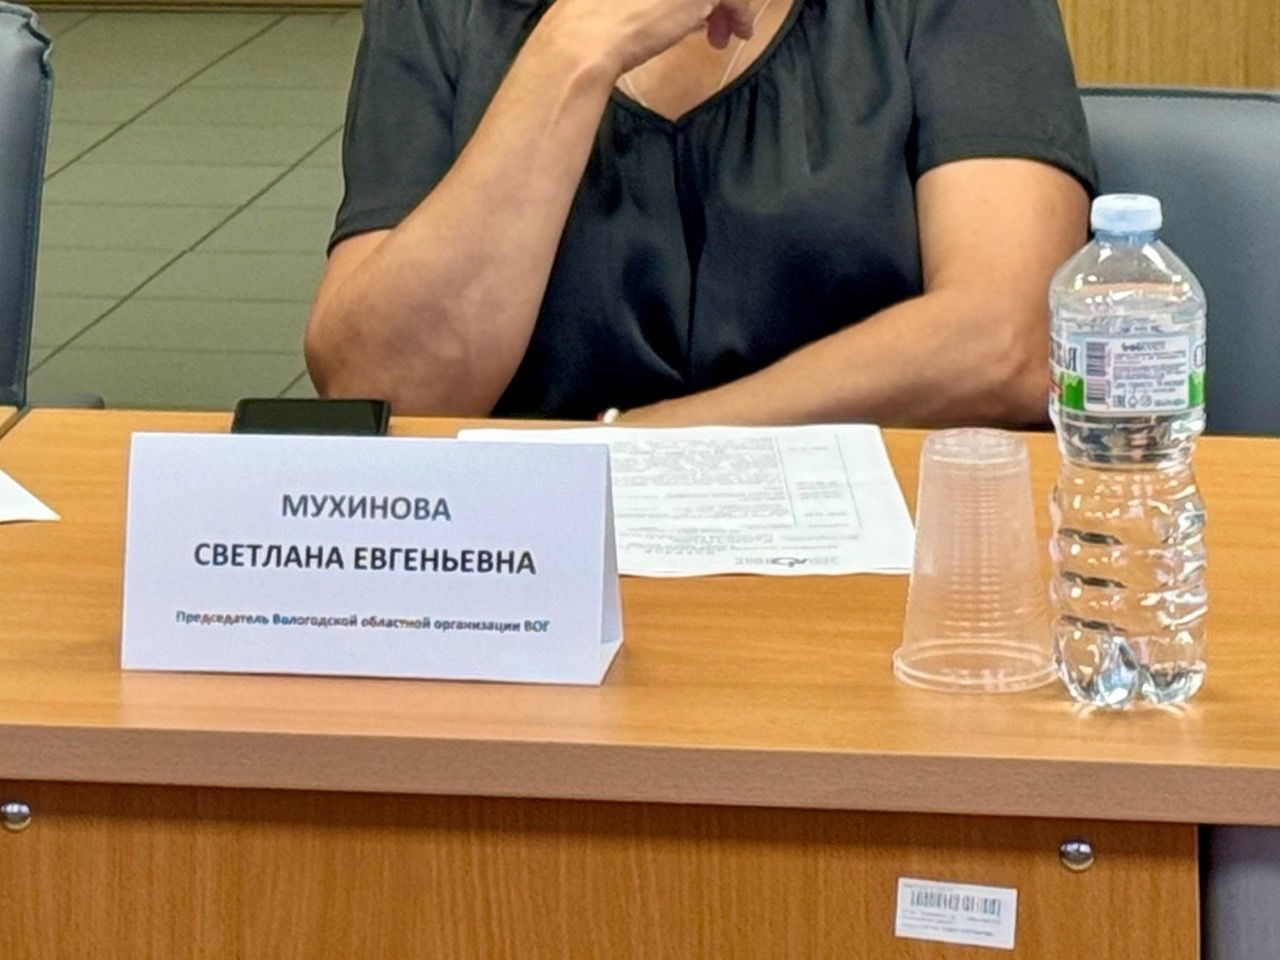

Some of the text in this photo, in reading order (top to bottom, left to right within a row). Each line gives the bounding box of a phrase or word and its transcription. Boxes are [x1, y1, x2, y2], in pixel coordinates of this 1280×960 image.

[281, 493, 452, 522] МУХИНОВА
[193, 542, 537, 576] СВЕТЛАНА ЕВГЕНЬЕВНА
[175, 609, 270, 626] Председатель
[272, 612, 358, 629] Вологодской
[360, 615, 432, 630] областной
[433, 619, 521, 634] организации
